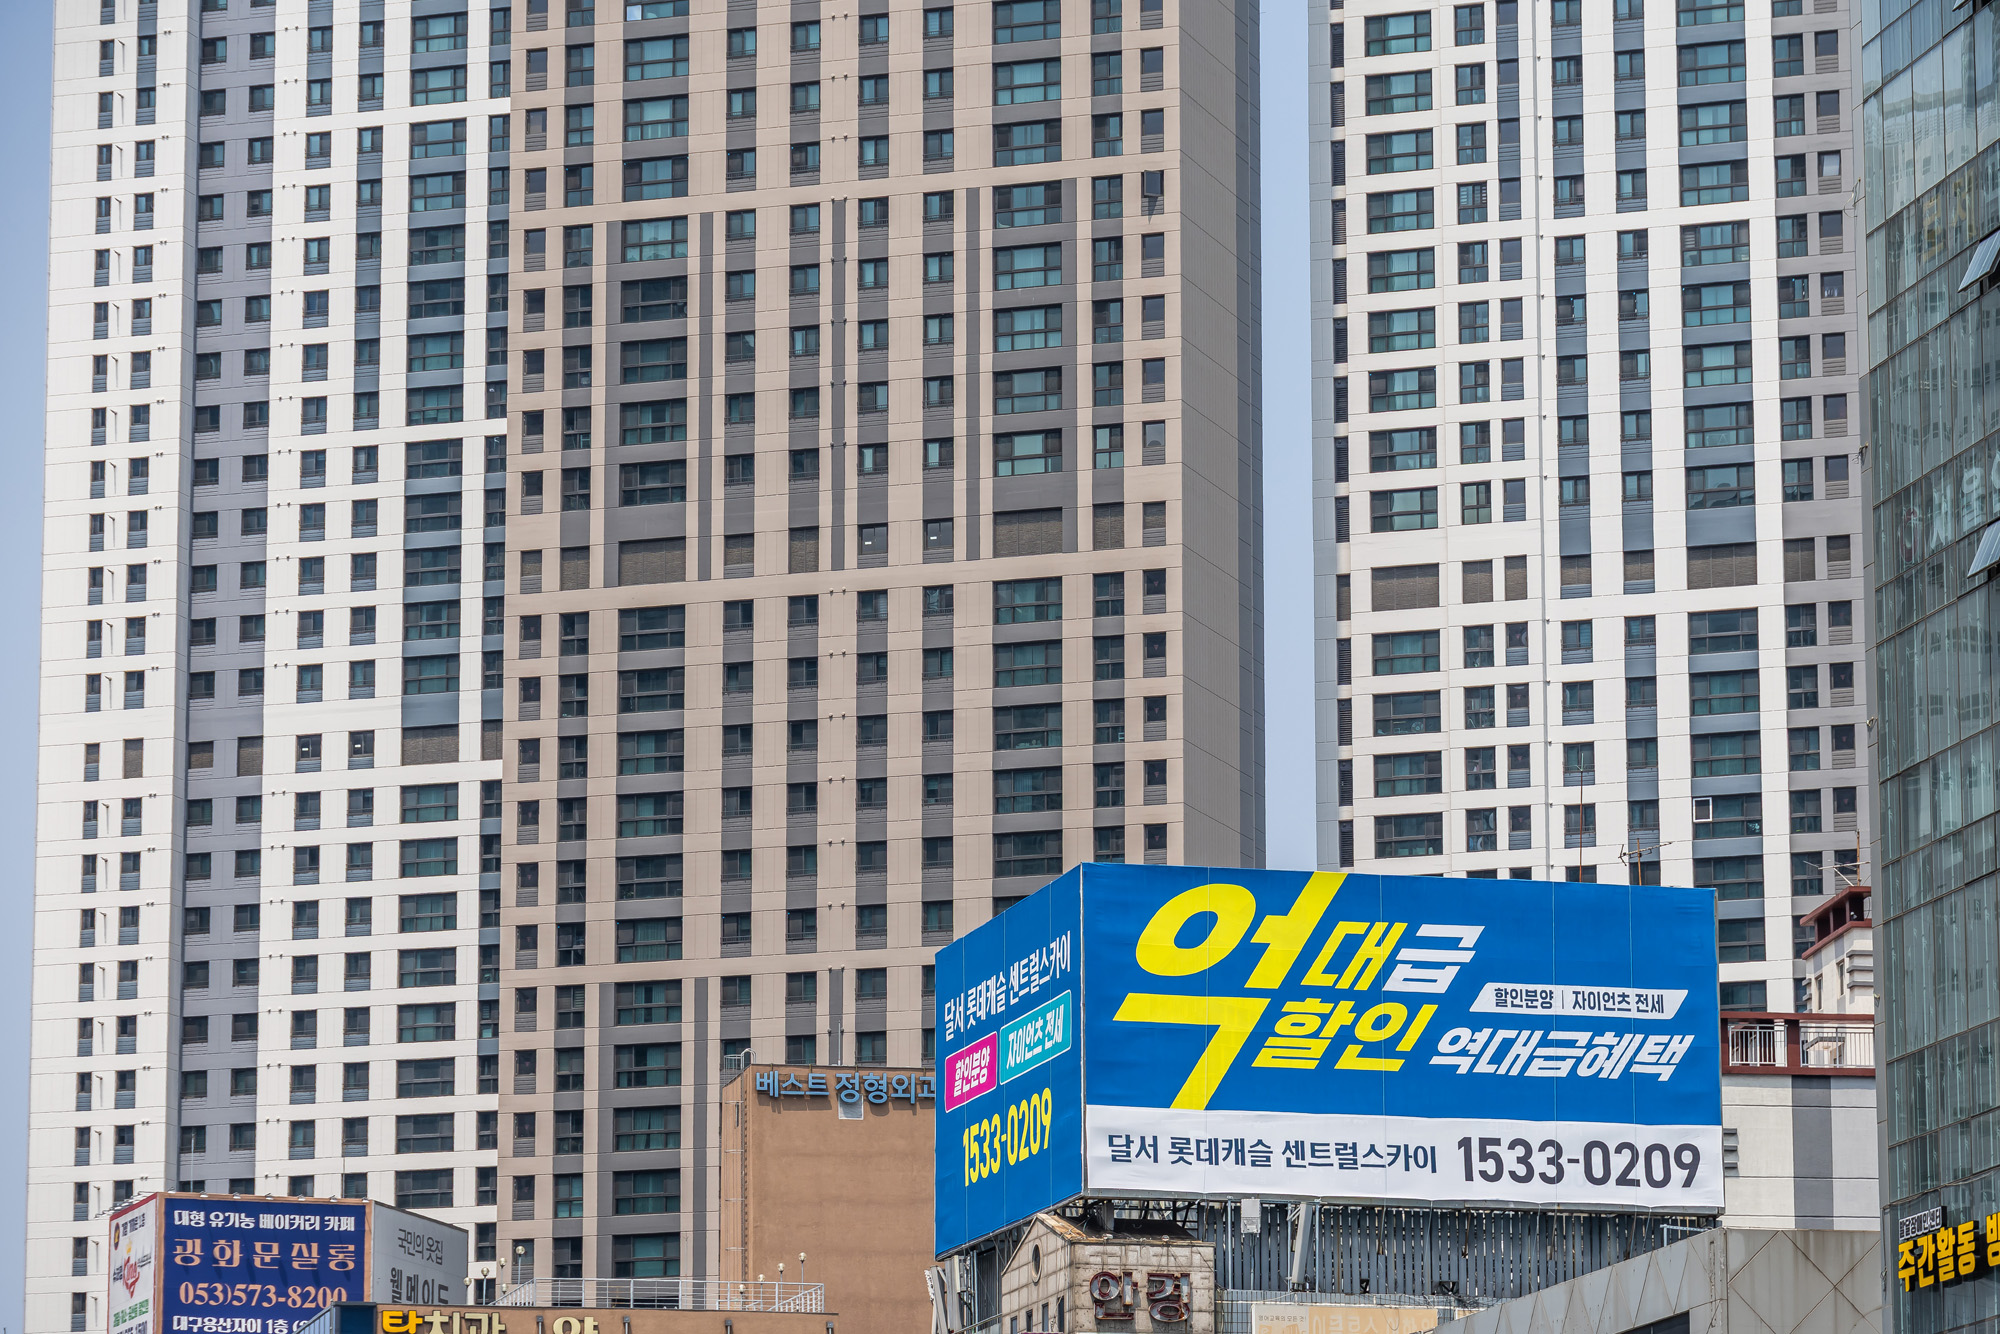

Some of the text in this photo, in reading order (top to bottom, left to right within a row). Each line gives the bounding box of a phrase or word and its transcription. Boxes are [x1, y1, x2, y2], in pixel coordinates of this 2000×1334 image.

[944, 930, 1071, 1042] 달서 롯데캐슬 센트럴스카이
[1494, 987, 1664, 1014] 할인분양 자이언츠 전세
[1006, 1004, 1064, 1070] 자이언츠 전세
[1252, 1001, 1438, 1071] 할인
[1428, 1027, 1695, 1082] 역대급혜택
[755, 1070, 830, 1098] 베스트
[953, 1045, 990, 1098] 할인분양
[962, 1087, 1052, 1187] 1533-0209
[1107, 1134, 1437, 1174] 달서 롯데캐슬 센트럴스카이
[1457, 1136, 1701, 1189] 1533-0209
[173, 1210, 356, 1232] 대형 유기농 베이커리 카페
[173, 1238, 356, 1271] 광화문살롱
[397, 1228, 444, 1266] 국민의 옷집
[1898, 1220, 1976, 1292] 주간활동
[179, 1281, 348, 1309] 053)573-8200
[1089, 1271, 1191, 1322] 안경
[172, 1315, 262, 1333] 대구용산자이
